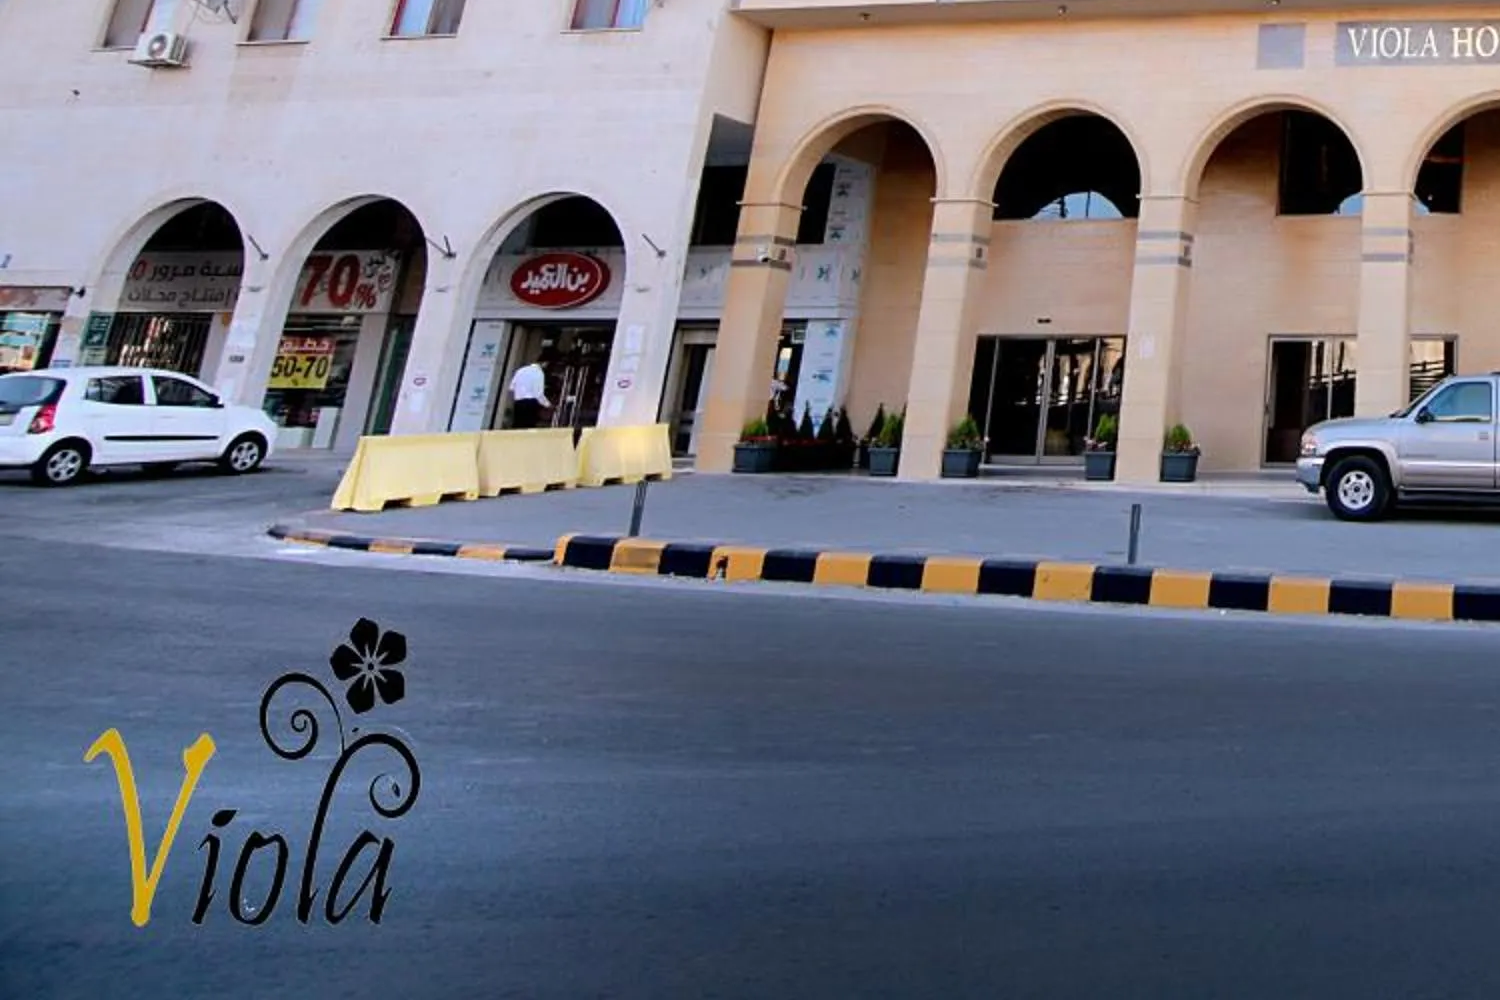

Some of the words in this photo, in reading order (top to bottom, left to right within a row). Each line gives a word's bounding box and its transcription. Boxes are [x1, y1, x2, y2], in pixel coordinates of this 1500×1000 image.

[1347, 26, 1439, 59] VIOLA
[520, 263, 568, 295] العميد
[566, 267, 591, 293] بن
